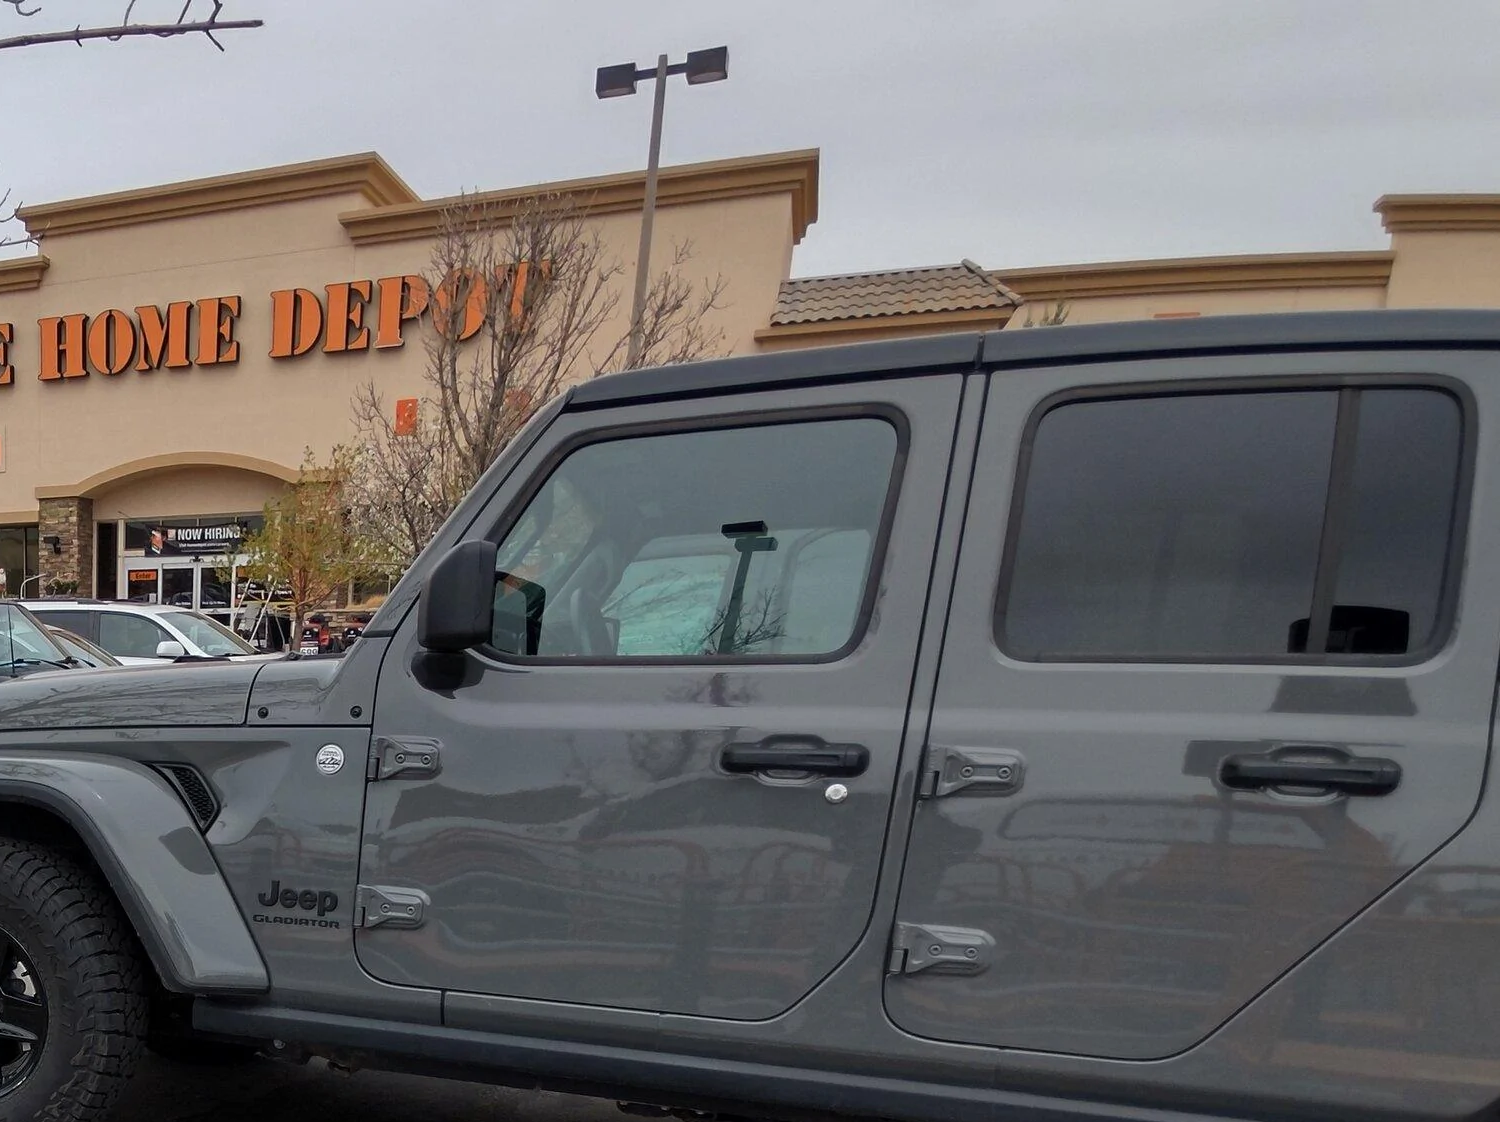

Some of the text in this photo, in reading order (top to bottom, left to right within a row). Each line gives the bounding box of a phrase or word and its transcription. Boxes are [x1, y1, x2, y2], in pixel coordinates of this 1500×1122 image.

[37, 295, 242, 382] HOME
[177, 528, 202, 541] NOW
[257, 880, 339, 917] Jeep
[252, 914, 340, 929] GLADIATOR
